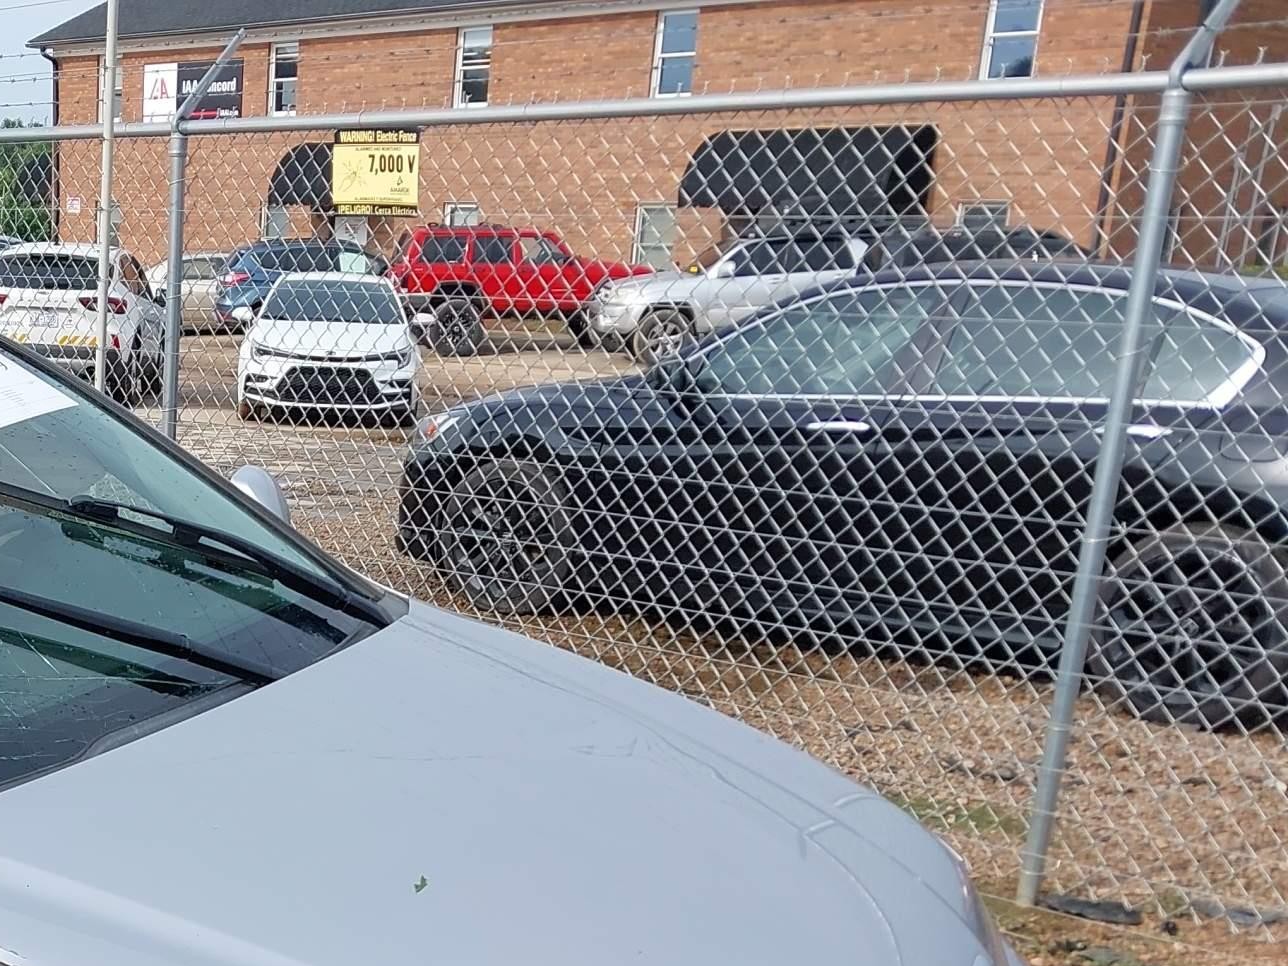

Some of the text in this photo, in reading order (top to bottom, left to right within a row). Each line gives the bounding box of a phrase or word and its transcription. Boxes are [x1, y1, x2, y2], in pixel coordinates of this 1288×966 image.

[207, 77, 237, 92] ncord
[339, 130, 375, 143] WARNING!
[376, 130, 398, 143] Electric
[368, 153, 416, 175] 7,000 V
